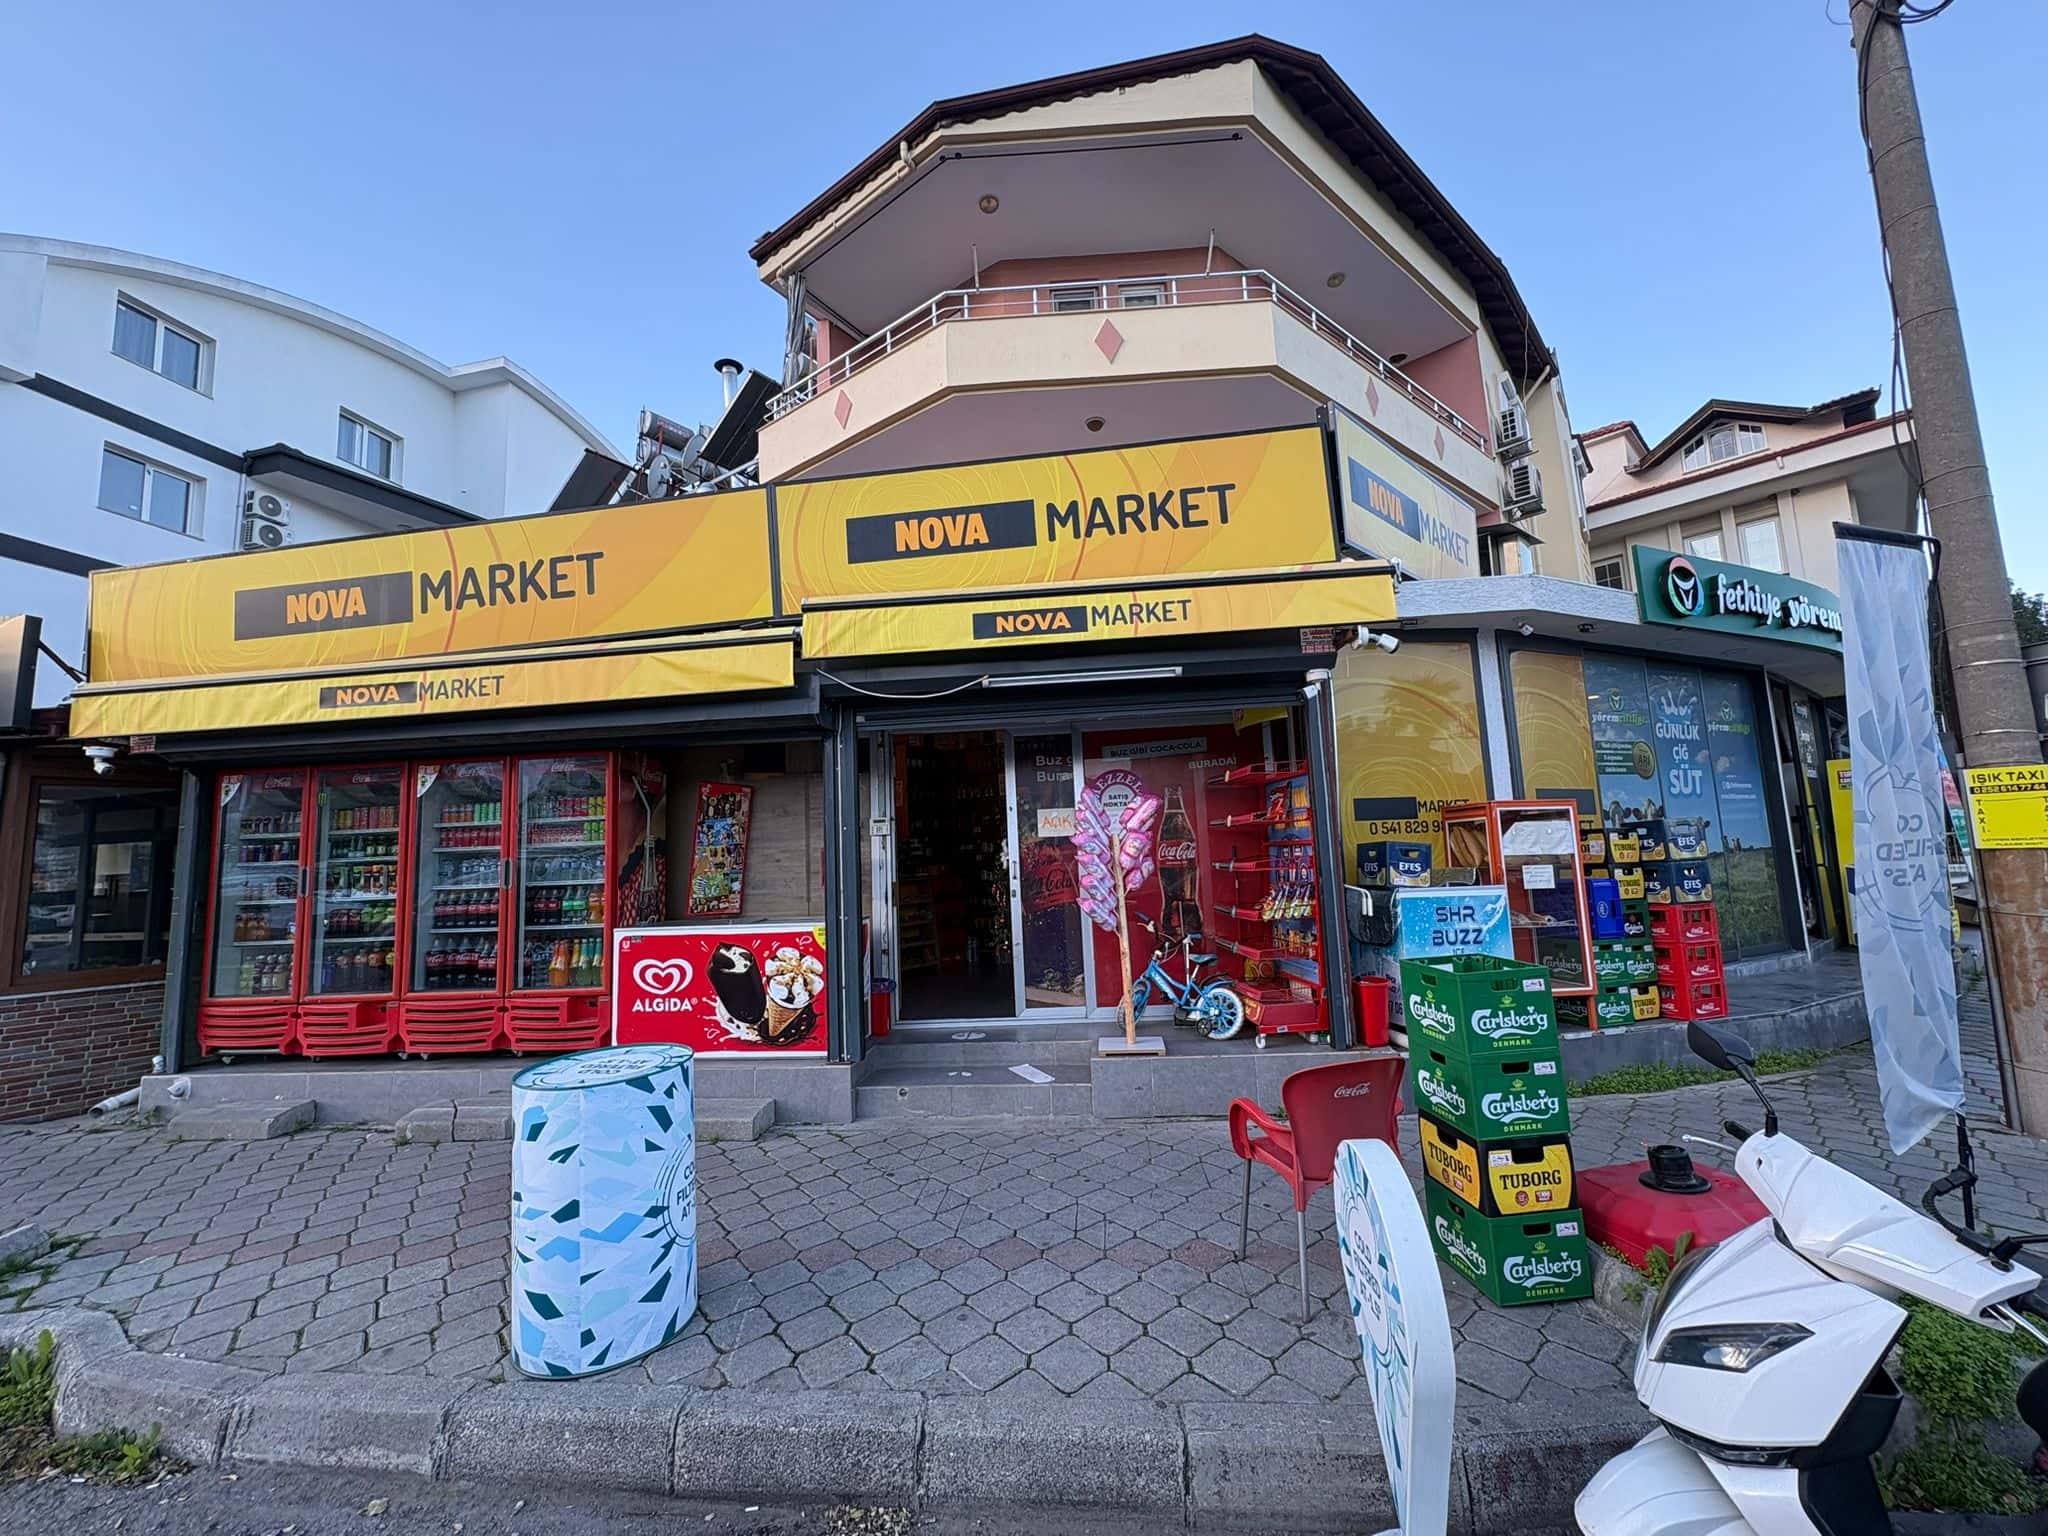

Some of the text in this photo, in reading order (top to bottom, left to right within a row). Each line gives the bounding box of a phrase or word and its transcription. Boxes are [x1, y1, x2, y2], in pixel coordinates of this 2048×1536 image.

[894, 483, 1237, 552] NOVA MARKET
[1367, 477, 1469, 568] NOVA MARKET
[286, 551, 605, 624] NOVA MARKET
[1717, 573, 1782, 625] fethiye
[995, 600, 1191, 634] NOVA MARKET
[335, 675, 505, 705] NOVA MARKET
[1655, 717, 1700, 740] GÜNLÜK
[1036, 755, 1064, 767] Buz
[1669, 764, 1703, 795] SÜT
[2006, 770, 2045, 781] TAXI
[1418, 799, 1469, 813] MAR
[1369, 822, 1378, 835] 0
[1381, 822, 1401, 835] 541
[1405, 821, 1429, 834] 829
[1677, 836, 1696, 846] EFES
[1399, 861, 1422, 872] EFES
[1684, 879, 1702, 889] EFES
[1435, 906, 1475, 923] SHR
[1432, 928, 1484, 946] BUZZ
[1626, 958, 1655, 975] Carlsberg
[1409, 993, 1456, 1034] Carlsberg
[1597, 1002, 1631, 1018] Carlsberg
[1471, 1006, 1549, 1039] Carlsberg
[1493, 1039, 1532, 1048] DENMARK
[1418, 1069, 1466, 1116] Carlsberg
[1481, 1089, 1559, 1124] Carlsberg
[1504, 1122, 1543, 1132] DENMARK
[1428, 1141, 1473, 1184] TUBORG
[1499, 1169, 1562, 1191] TUBORG
[1435, 1215, 1487, 1276] Carlsberg
[1503, 1252, 1582, 1288] Carlsberg
[1526, 1286, 1565, 1297] DENMARK
